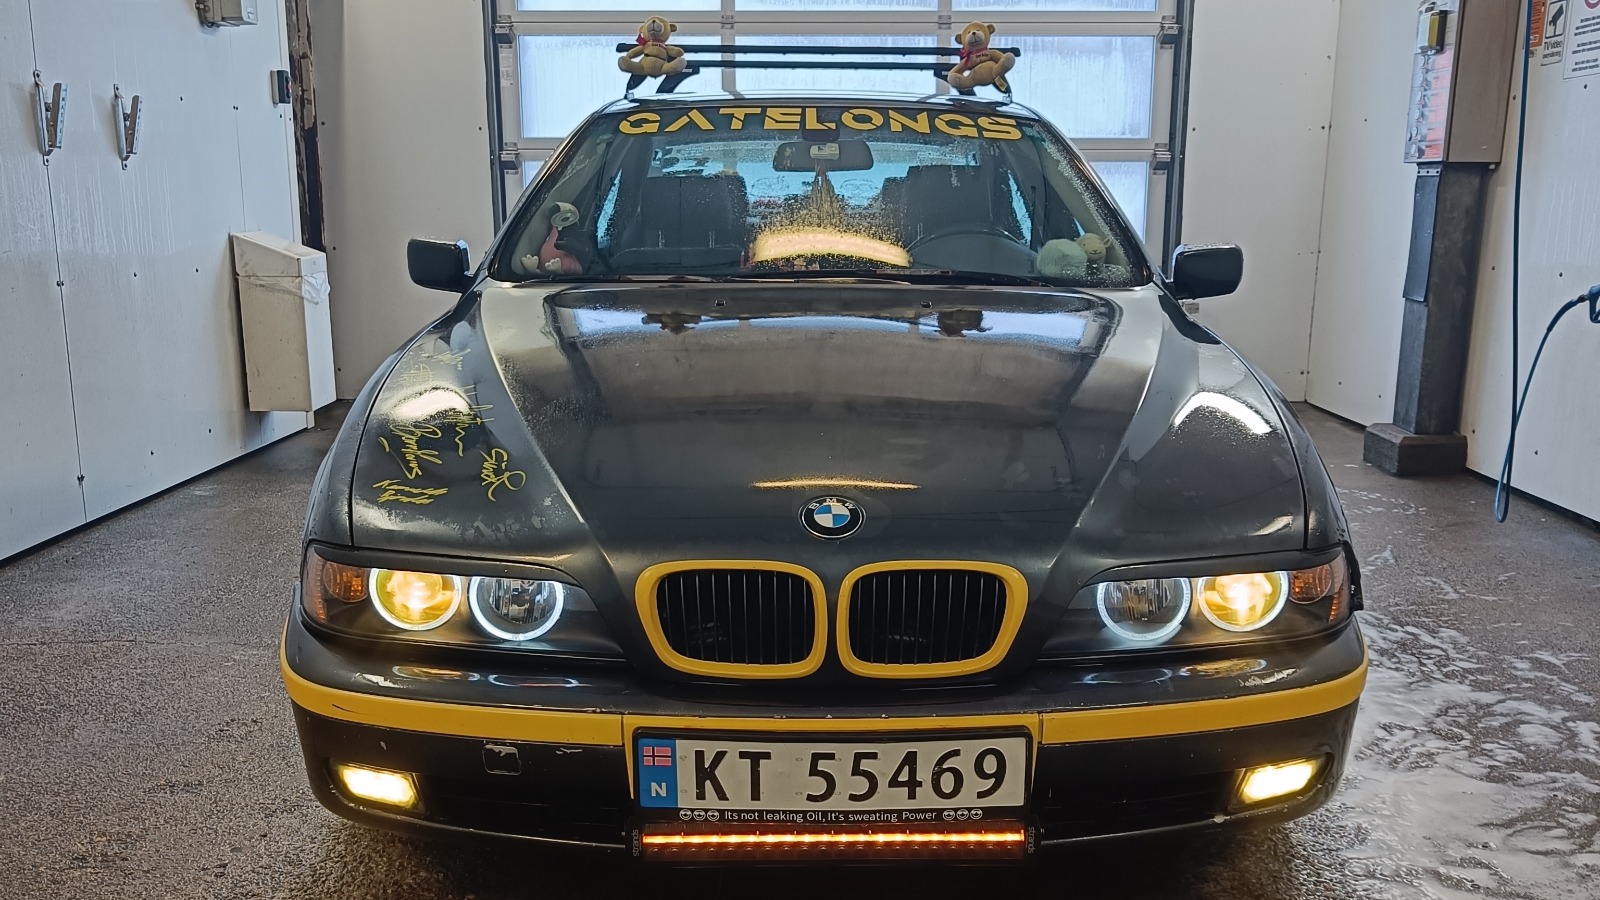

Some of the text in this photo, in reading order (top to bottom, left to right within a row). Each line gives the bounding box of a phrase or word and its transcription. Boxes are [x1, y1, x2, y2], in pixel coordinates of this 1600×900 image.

[618, 107, 1023, 140] GATELONGS
[808, 498, 856, 510] BMW
[694, 747, 1008, 802] KT 55469
[650, 782, 667, 797] N
[725, 811, 937, 822] Its not leaking Oil, It's sweating Power
[631, 829, 640, 857] strands
[1027, 826, 1036, 854] strands
